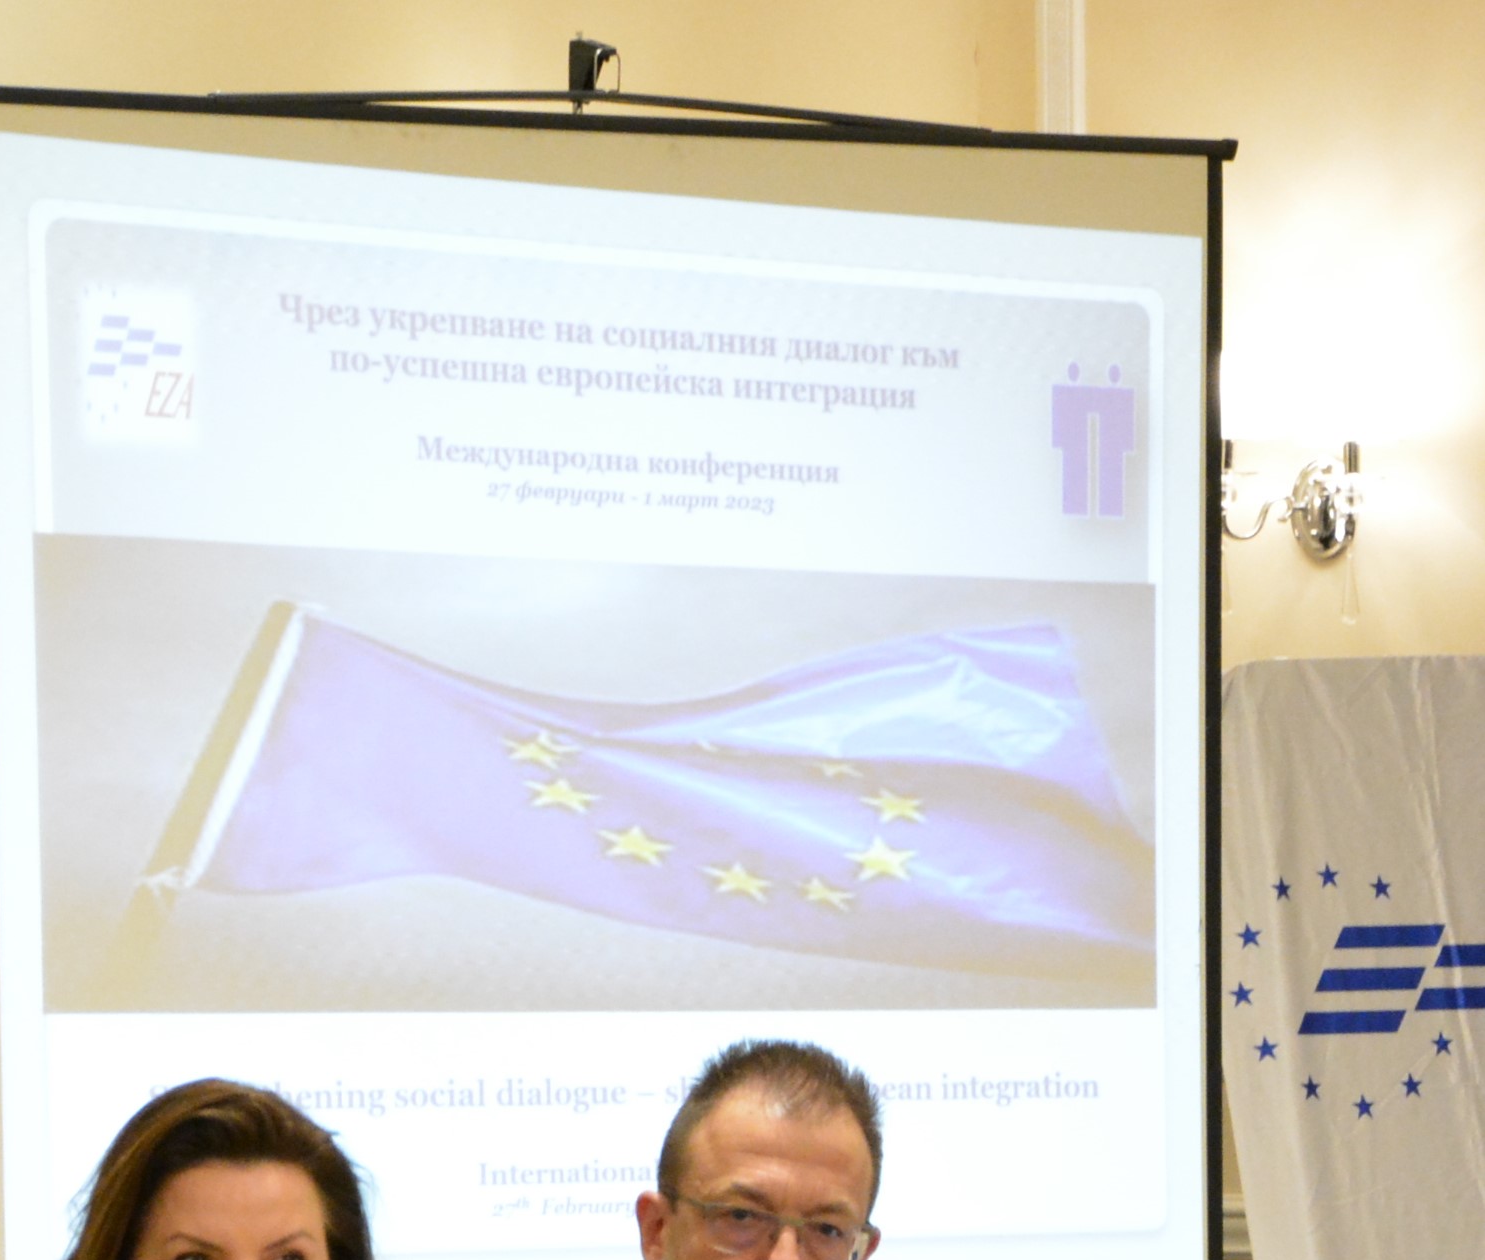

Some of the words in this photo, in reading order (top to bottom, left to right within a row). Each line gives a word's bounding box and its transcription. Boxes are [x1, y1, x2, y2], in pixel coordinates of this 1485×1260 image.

[279, 293, 360, 333] Чрез
[369, 308, 545, 340] укрепване
[555, 322, 593, 344] на
[603, 327, 776, 357] социалния
[785, 339, 893, 365] диалог
[902, 346, 959, 369] към
[144, 371, 194, 419] EZA
[331, 350, 527, 383] по-успешна
[537, 364, 723, 397] европейска
[734, 379, 916, 412] интеграция
[418, 435, 639, 474] Международна
[649, 452, 839, 484] конференция
[487, 483, 511, 501] 27
[515, 481, 624, 508] февруари
[658, 494, 719, 513] март
[725, 496, 775, 515] 2023
[395, 1079, 485, 1107] social
[496, 1078, 626, 1112] dialogue
[942, 1072, 1098, 1106] integration
[542, 1196, 636, 1218] February
